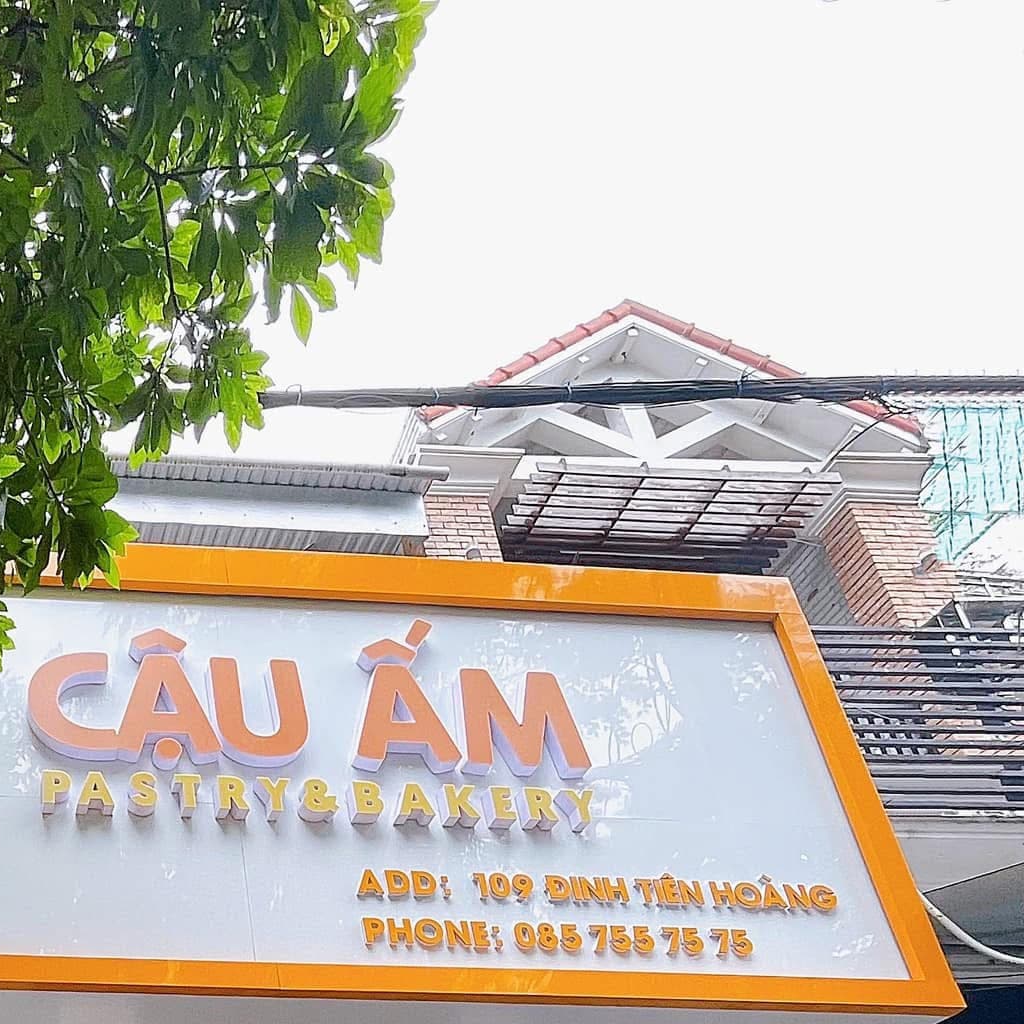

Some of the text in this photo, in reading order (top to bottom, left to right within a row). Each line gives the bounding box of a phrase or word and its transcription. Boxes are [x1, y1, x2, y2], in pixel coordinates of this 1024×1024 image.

[27, 618, 593, 779] CẬU ẤM
[357, 869, 838, 914] ADD: 109 ĐINH TIÊN HOÀNG
[361, 918, 754, 957] PHONE: 085 755 75 75
